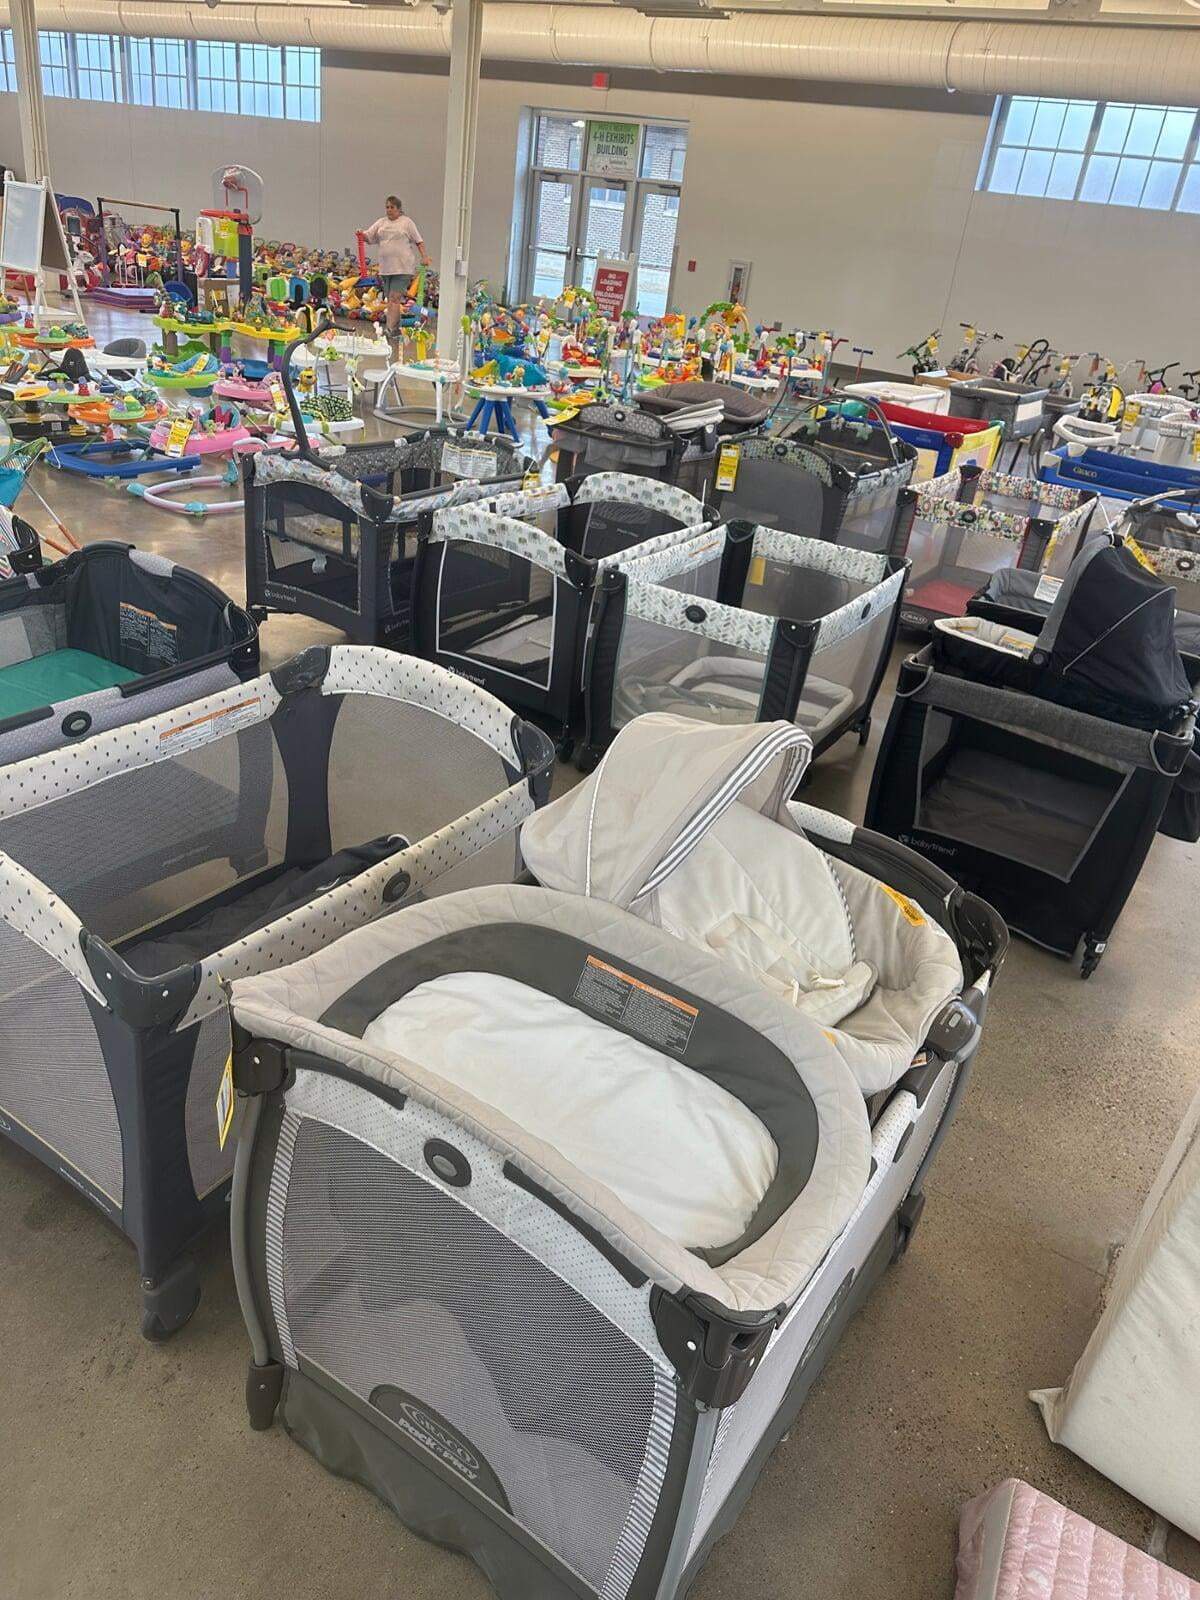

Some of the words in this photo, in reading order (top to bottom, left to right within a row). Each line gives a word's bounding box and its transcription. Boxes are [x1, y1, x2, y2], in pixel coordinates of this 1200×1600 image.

[605, 131, 635, 145] EXHIBITS
[596, 143, 629, 157] BUILDING
[600, 278, 623, 288] LOADING
[594, 290, 624, 300] UNLOADING
[1073, 466, 1098, 479] GRACO
[910, 836, 955, 856] babytrend
[411, 1410, 471, 1463] GRACO
[398, 1417, 437, 1449] Pack
[442, 1450, 478, 1480] Play
